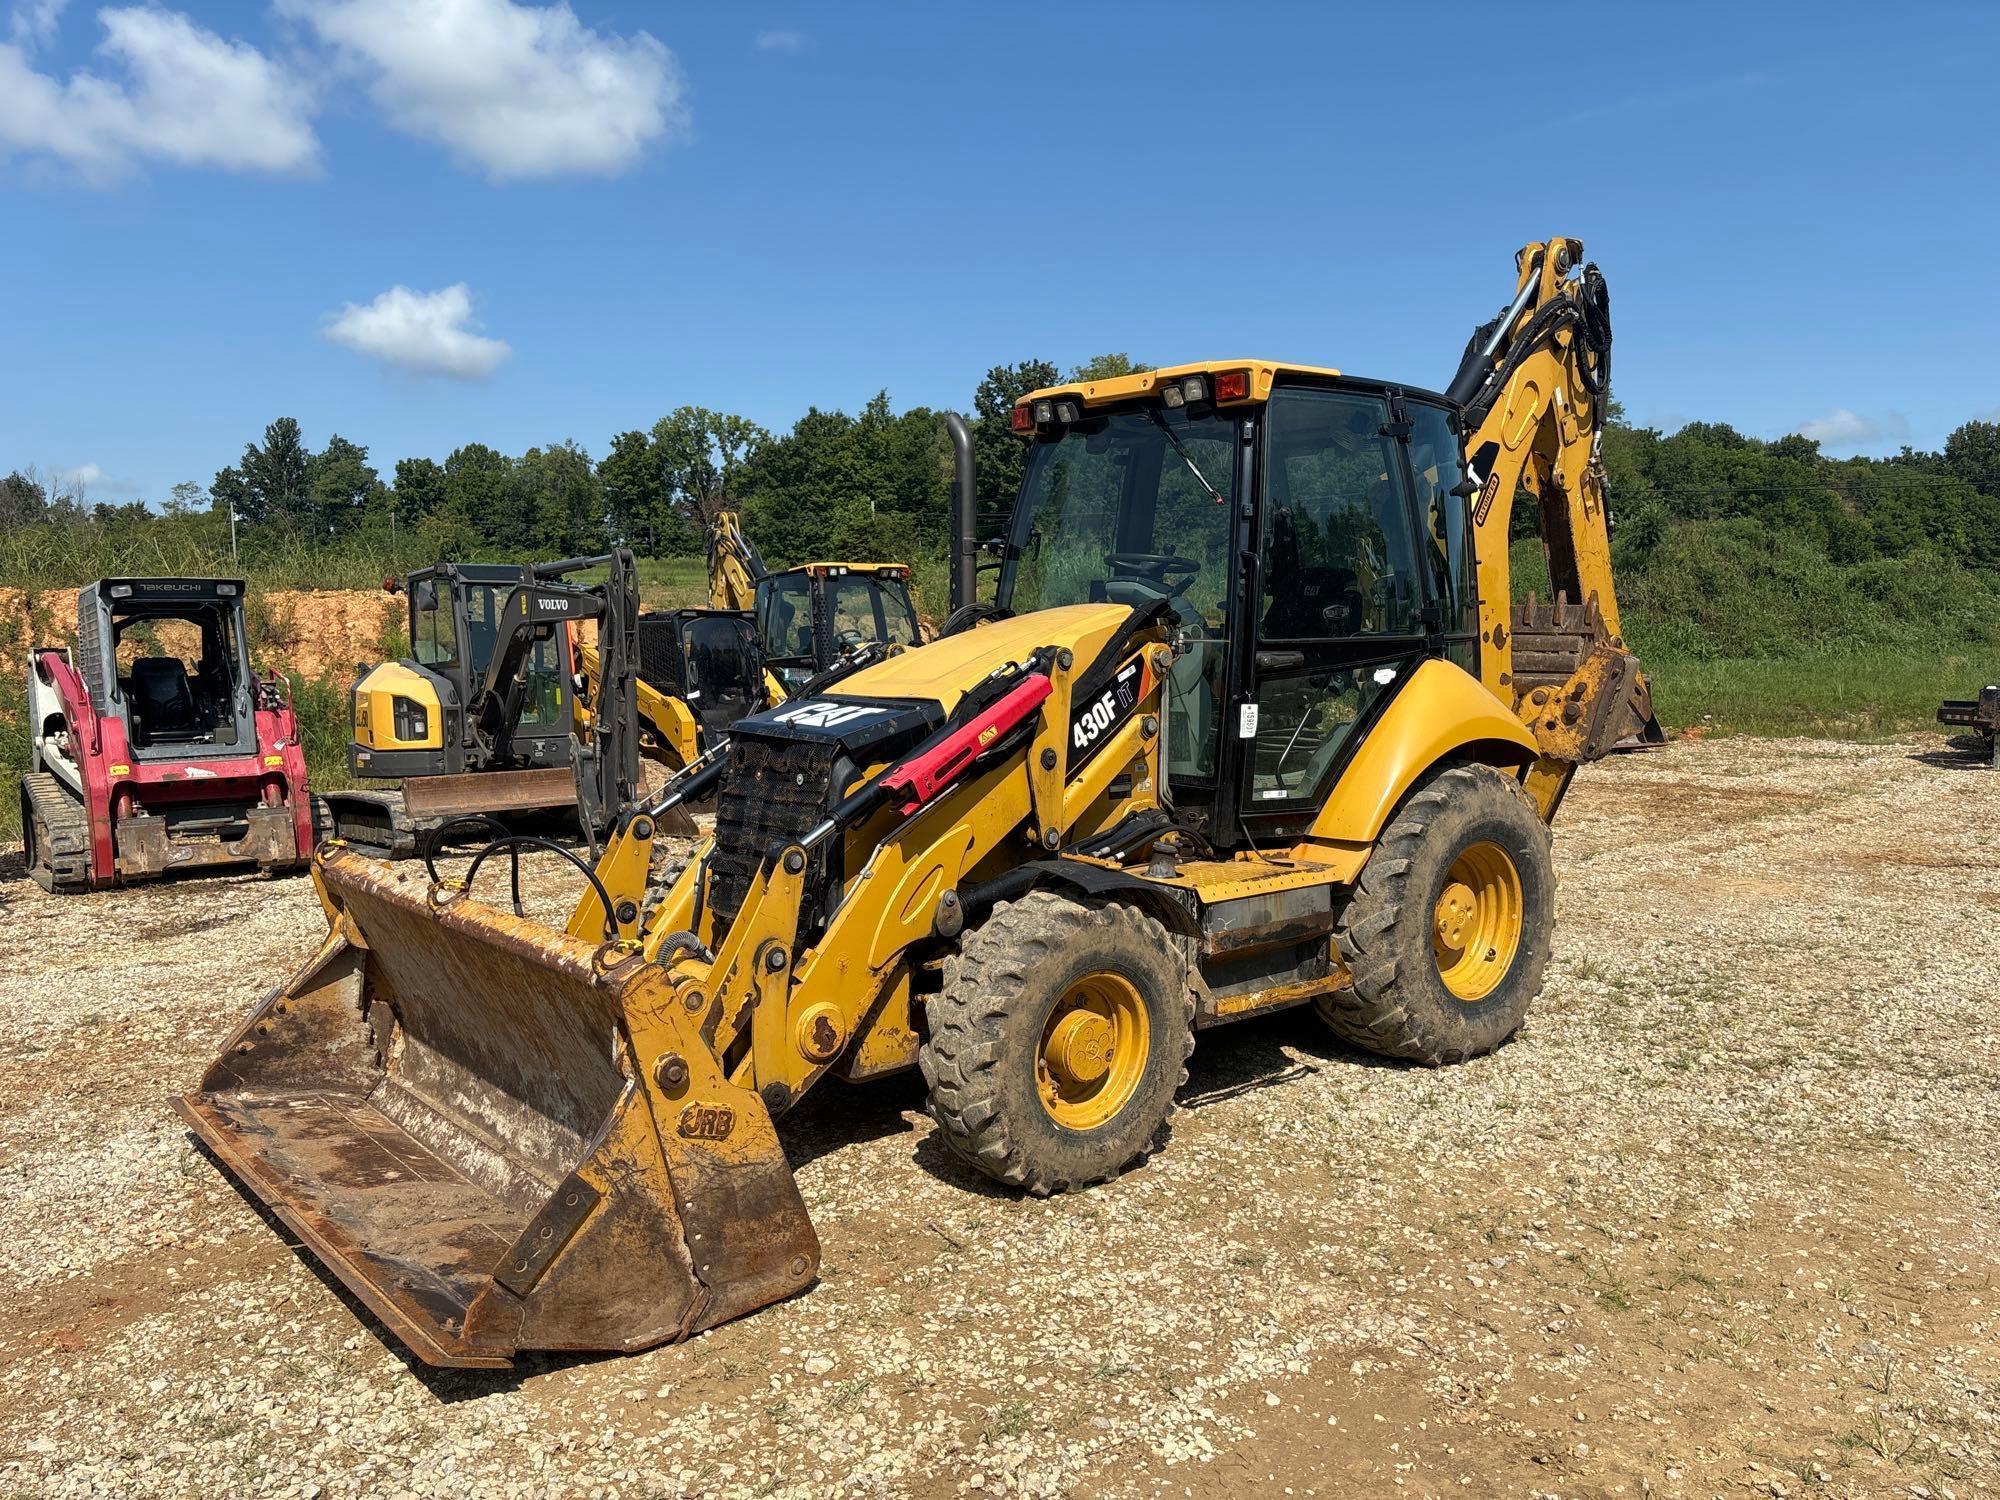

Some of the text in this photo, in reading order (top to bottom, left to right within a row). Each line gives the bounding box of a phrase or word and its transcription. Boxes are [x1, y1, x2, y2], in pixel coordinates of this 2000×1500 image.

[1478, 479, 1497, 520] ALTORFER
[1304, 585, 1321, 596] CAT
[538, 599, 568, 610] VOLVO
[773, 703, 889, 727] CAT
[1073, 681, 1134, 749] 430F IT
[684, 1108, 733, 1136] JRB
